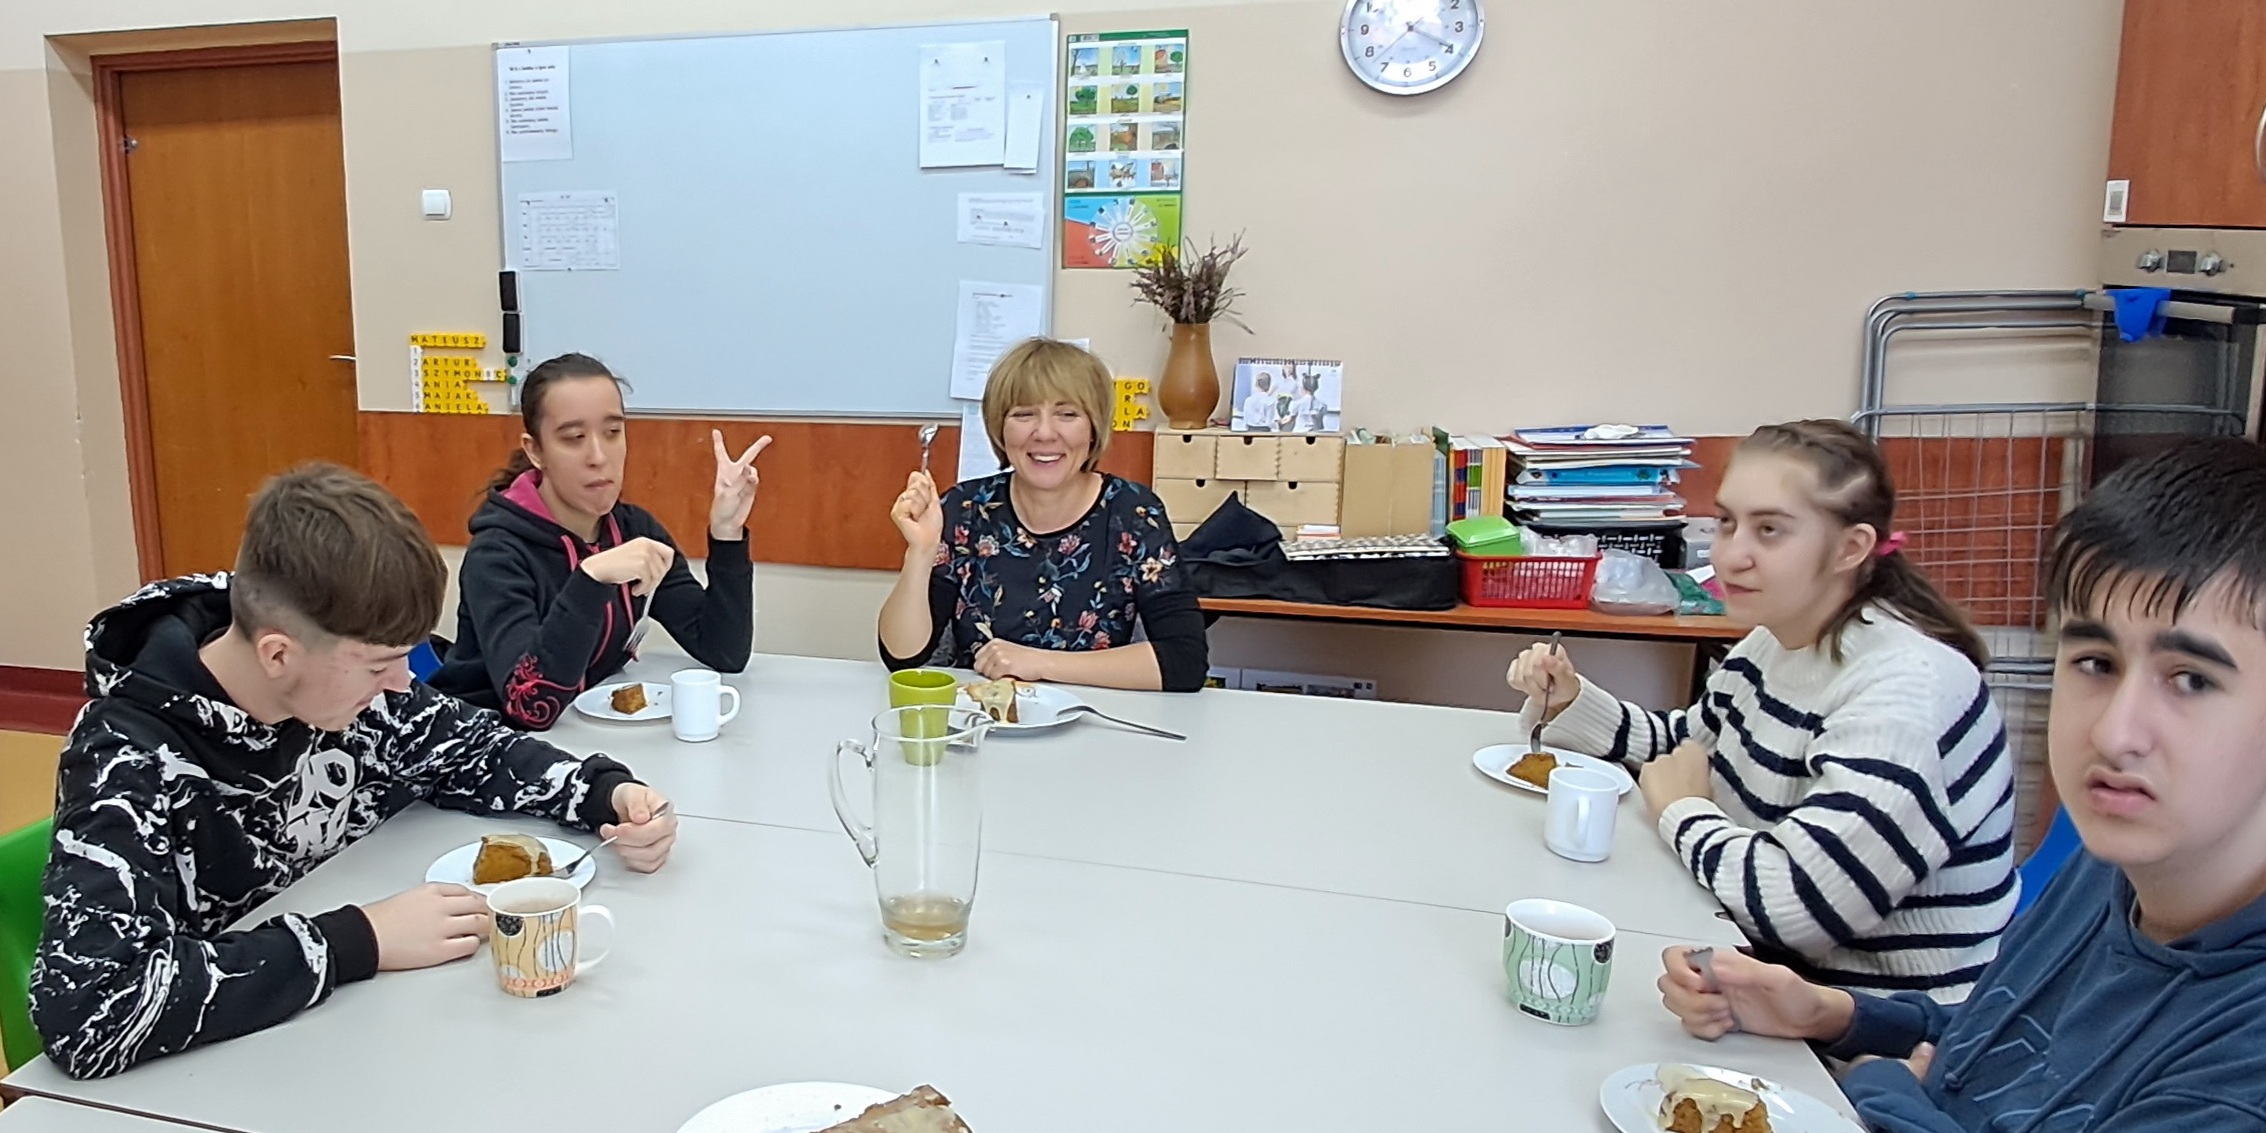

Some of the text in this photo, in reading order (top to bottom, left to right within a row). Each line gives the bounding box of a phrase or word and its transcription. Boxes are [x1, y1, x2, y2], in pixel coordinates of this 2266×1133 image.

[1360, 24, 1369, 35] 9
[1454, 21, 1464, 33] 3
[1365, 46, 1375, 57] 8
[1444, 43, 1454, 55] 4
[1380, 62, 1389, 73] 7
[1428, 61, 1437, 71] 5
[1403, 67, 1412, 77] 6
[411, 335, 481, 345] MATEUSZ
[423, 358, 470, 367] ARTUR
